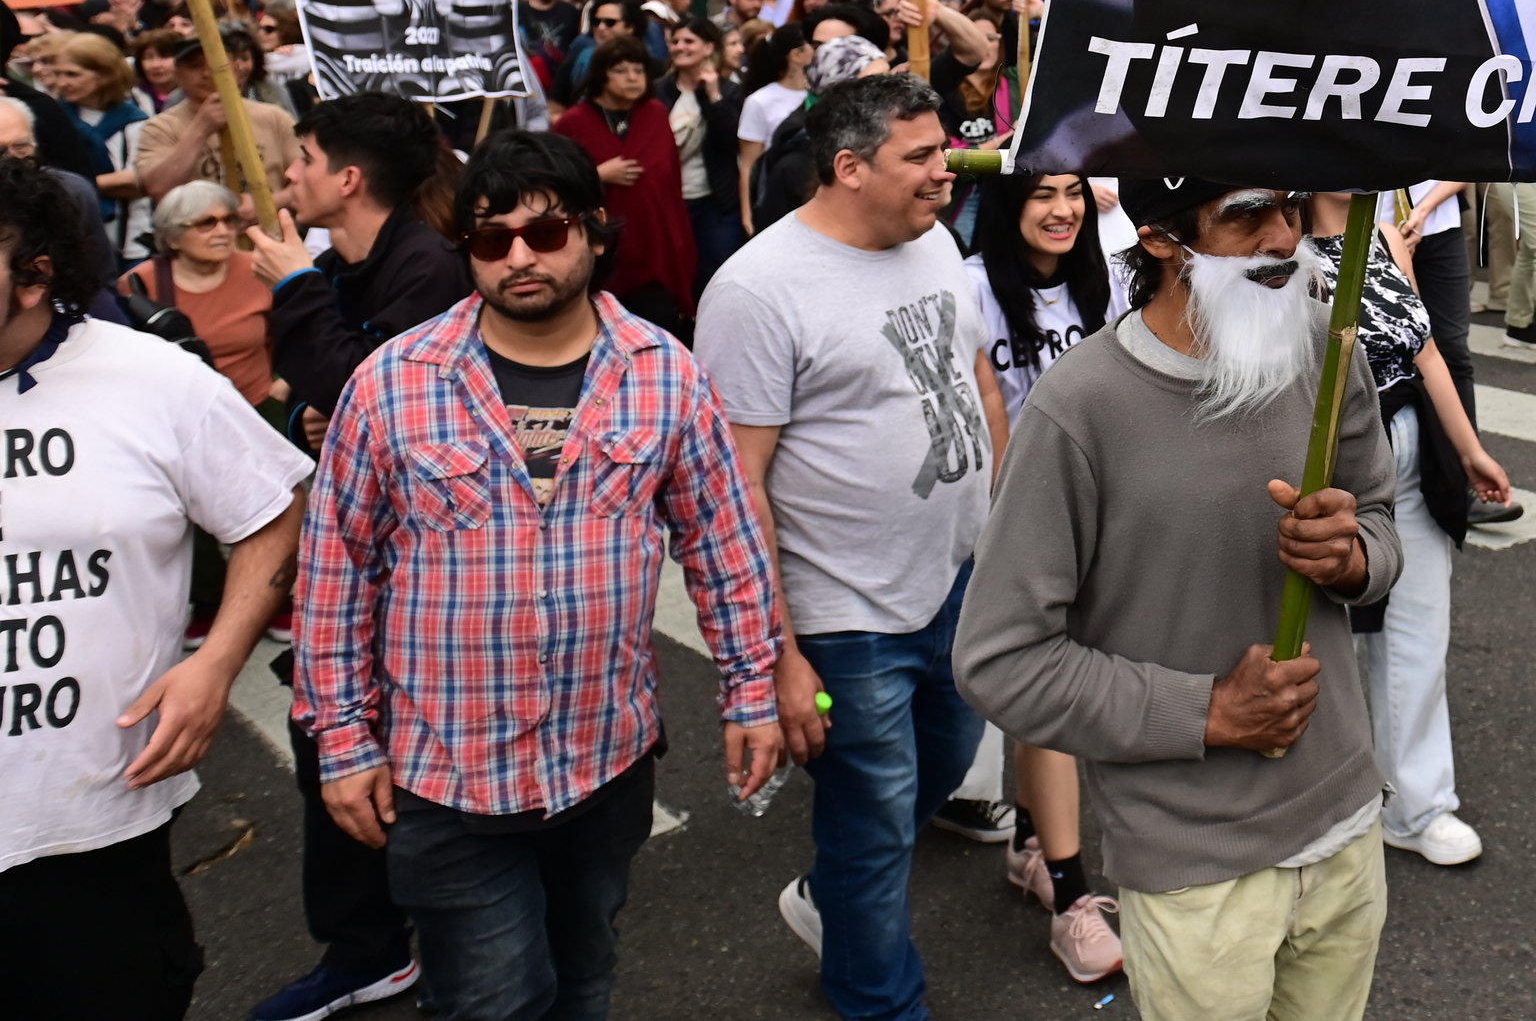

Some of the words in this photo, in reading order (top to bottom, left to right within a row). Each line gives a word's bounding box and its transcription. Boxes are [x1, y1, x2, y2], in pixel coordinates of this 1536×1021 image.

[343, 53, 420, 73] Traición
[1088, 23, 1447, 128] TÍTERE
[4, 427, 75, 478] RO
[0, 549, 112, 606] HAS
[0, 676, 80, 737] RO
